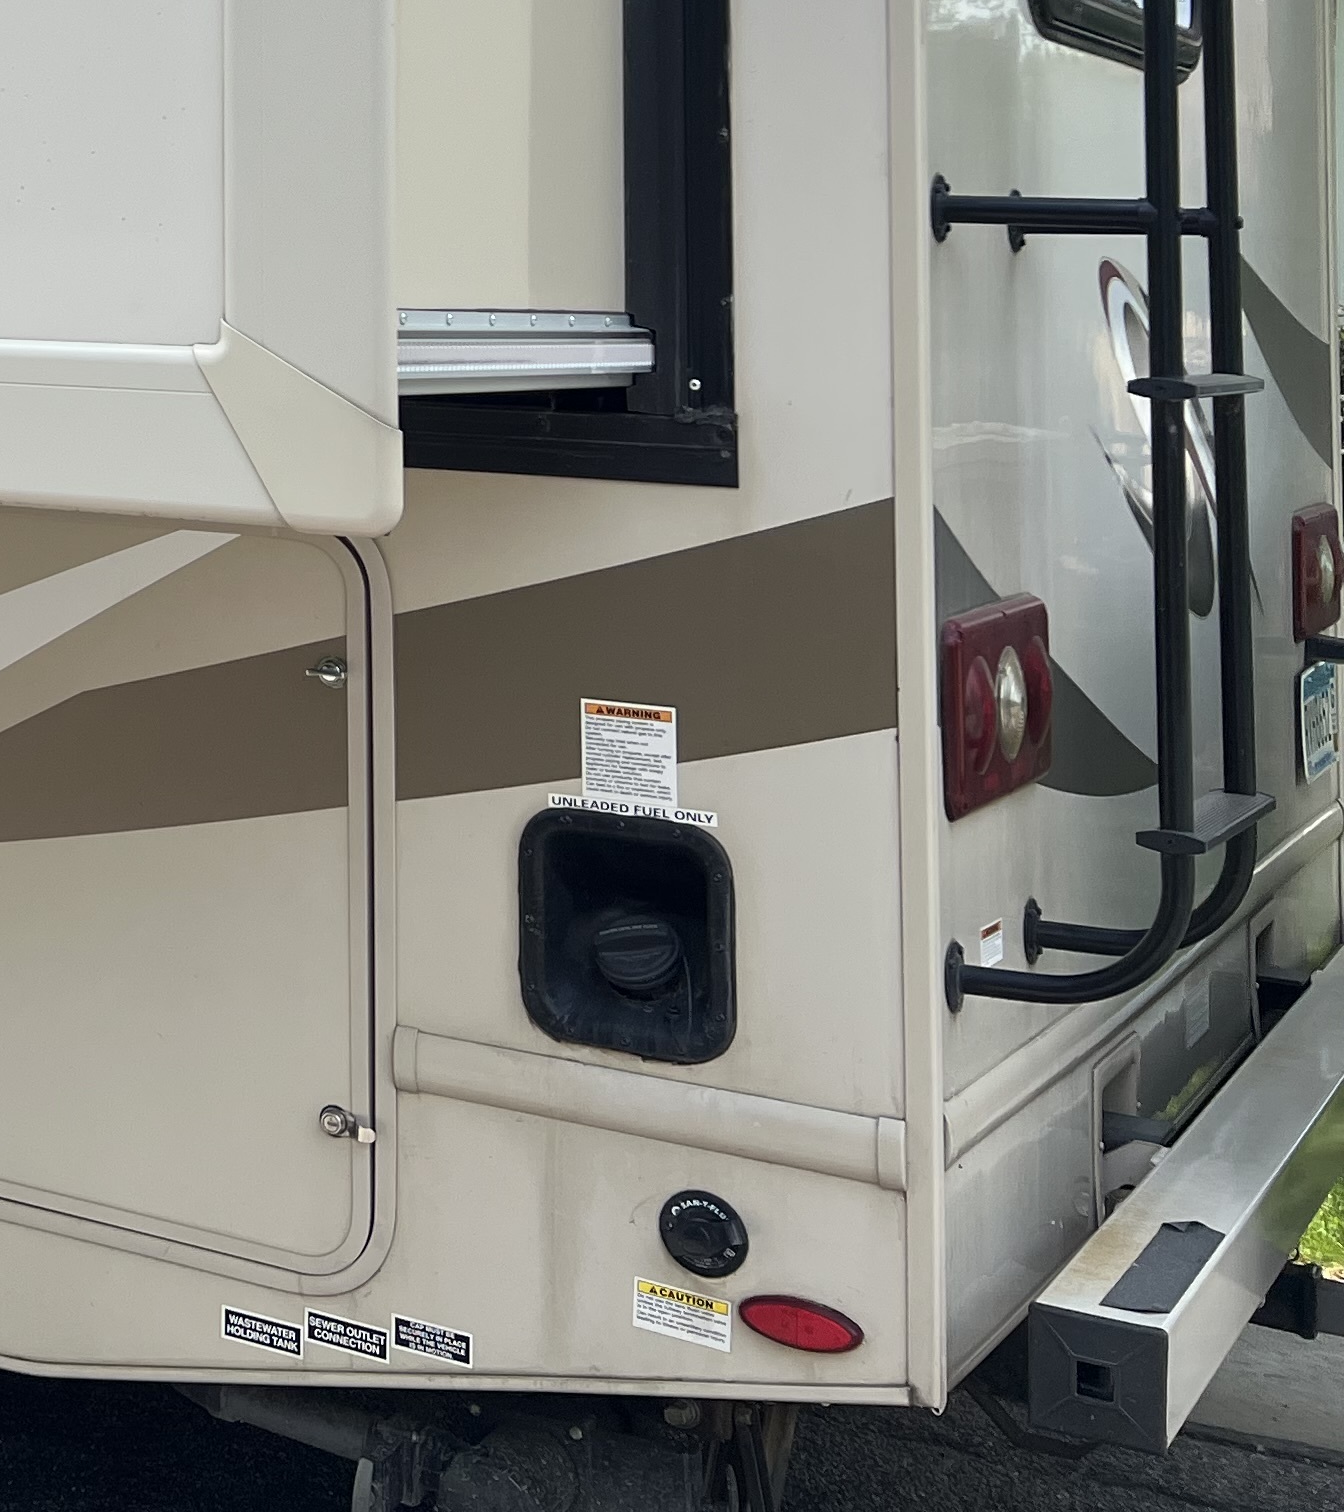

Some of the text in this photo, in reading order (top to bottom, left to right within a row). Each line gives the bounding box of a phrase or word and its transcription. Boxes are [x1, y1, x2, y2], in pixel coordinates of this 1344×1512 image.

[605, 706, 661, 720] WARNING
[551, 795, 714, 823] UNLEADED FUEL ONLY
[659, 1289, 714, 1310] CAUTION
[226, 1325, 299, 1352] HOLDING TANK
[229, 1314, 296, 1341] WASTEWATER
[309, 1316, 386, 1346] SEWER OUTLET
[314, 1329, 380, 1355] CONNECTION
